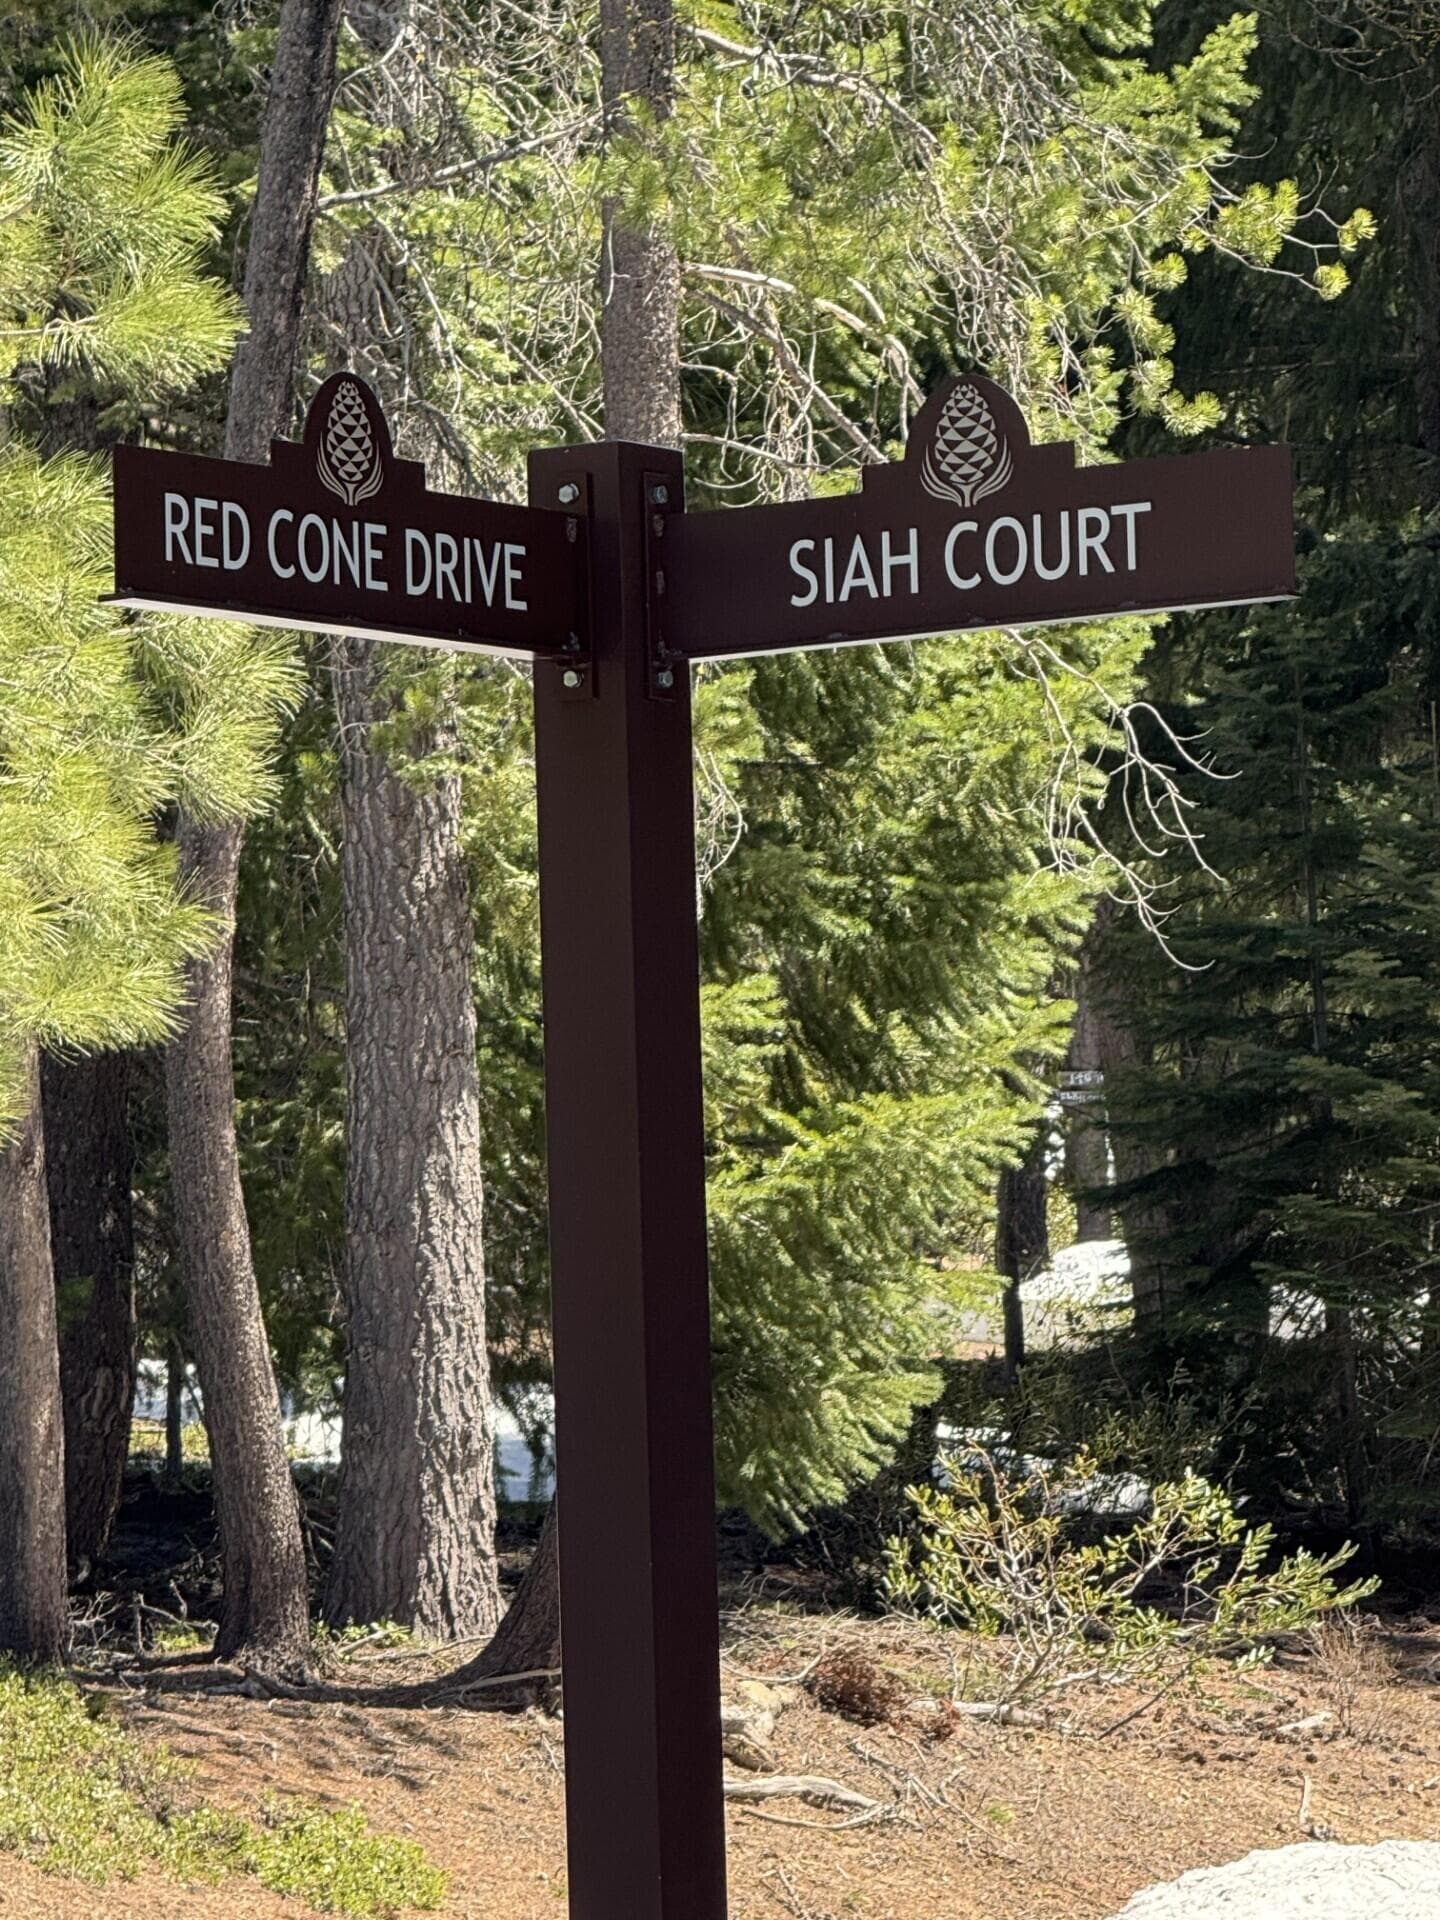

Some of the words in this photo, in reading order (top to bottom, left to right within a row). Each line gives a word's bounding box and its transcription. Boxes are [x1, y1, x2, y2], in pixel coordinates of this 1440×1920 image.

[164, 492, 250, 570] RED
[267, 509, 388, 591] CONE
[405, 528, 527, 611] DRIVE
[789, 527, 919, 607] SIAH
[944, 501, 1152, 590] COURT
